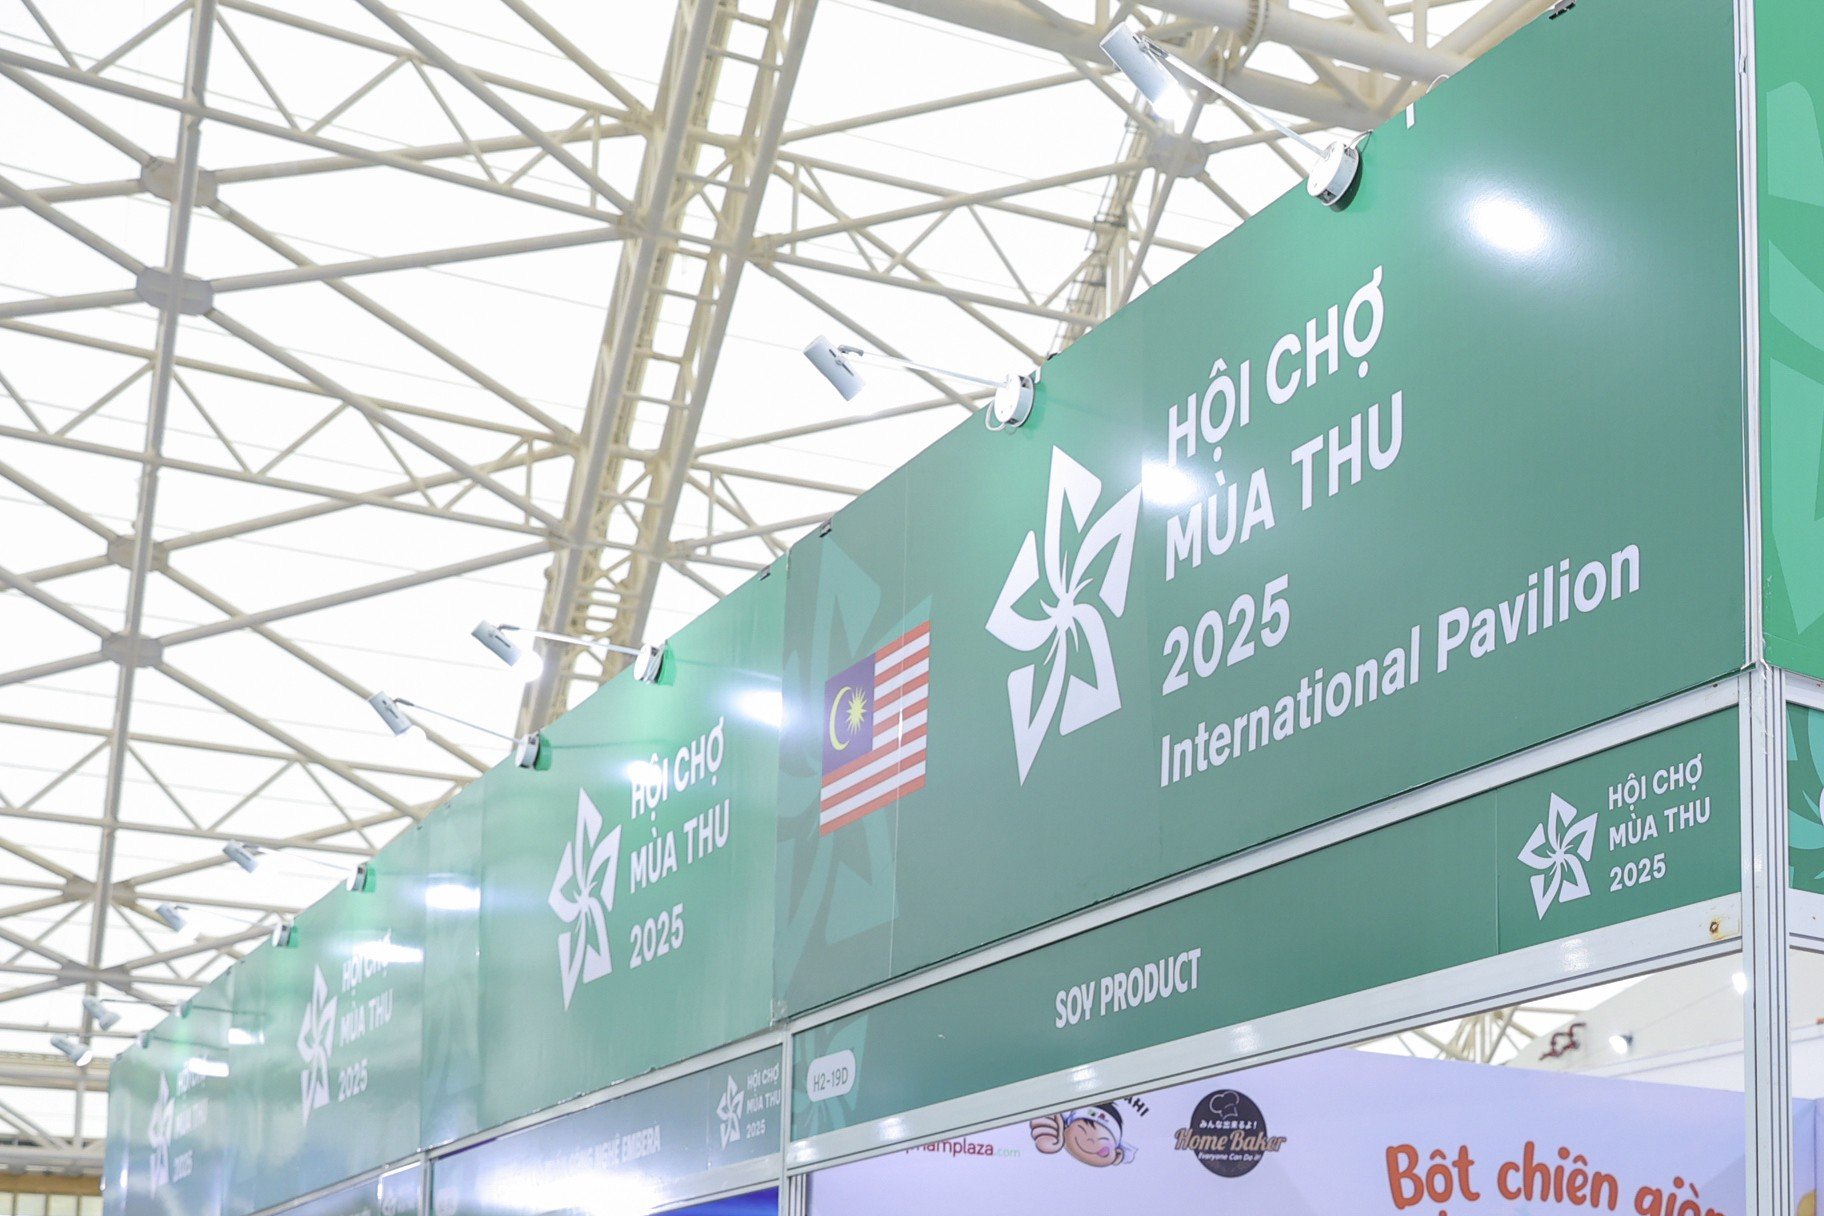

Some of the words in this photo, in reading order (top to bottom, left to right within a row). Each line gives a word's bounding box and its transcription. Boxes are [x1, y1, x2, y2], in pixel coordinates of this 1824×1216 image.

[1167, 359, 1251, 470] HỘI
[1264, 265, 1386, 406] CHỢ
[1165, 463, 1275, 582] MÙA
[1290, 391, 1404, 511] THU
[1159, 624, 1421, 788] International
[1436, 543, 1641, 675] Pavilion
[1161, 574, 1291, 696] 2025
[673, 717, 725, 792] CHỢ
[1607, 770, 1648, 813] HỘI
[1652, 752, 1704, 798] CHỢ
[629, 828, 678, 894] MÙA
[684, 798, 731, 865] THU
[1608, 806, 1659, 853] MÙA
[1664, 795, 1713, 837] THU
[1608, 853, 1667, 893] 2025
[629, 903, 685, 969] 2025
[1055, 988, 1095, 1030] SOY
[1099, 947, 1203, 1018] PRODUCT
[337, 1059, 369, 1103] 2025
[764, 1088, 782, 1108] THU
[812, 1066, 850, 1094] H2-19D
[745, 1121, 767, 1141] 2025
[1174, 1127, 1227, 1154] Home
[1229, 1129, 1287, 1154] Baker
[1497, 1140, 1619, 1212] chiên
